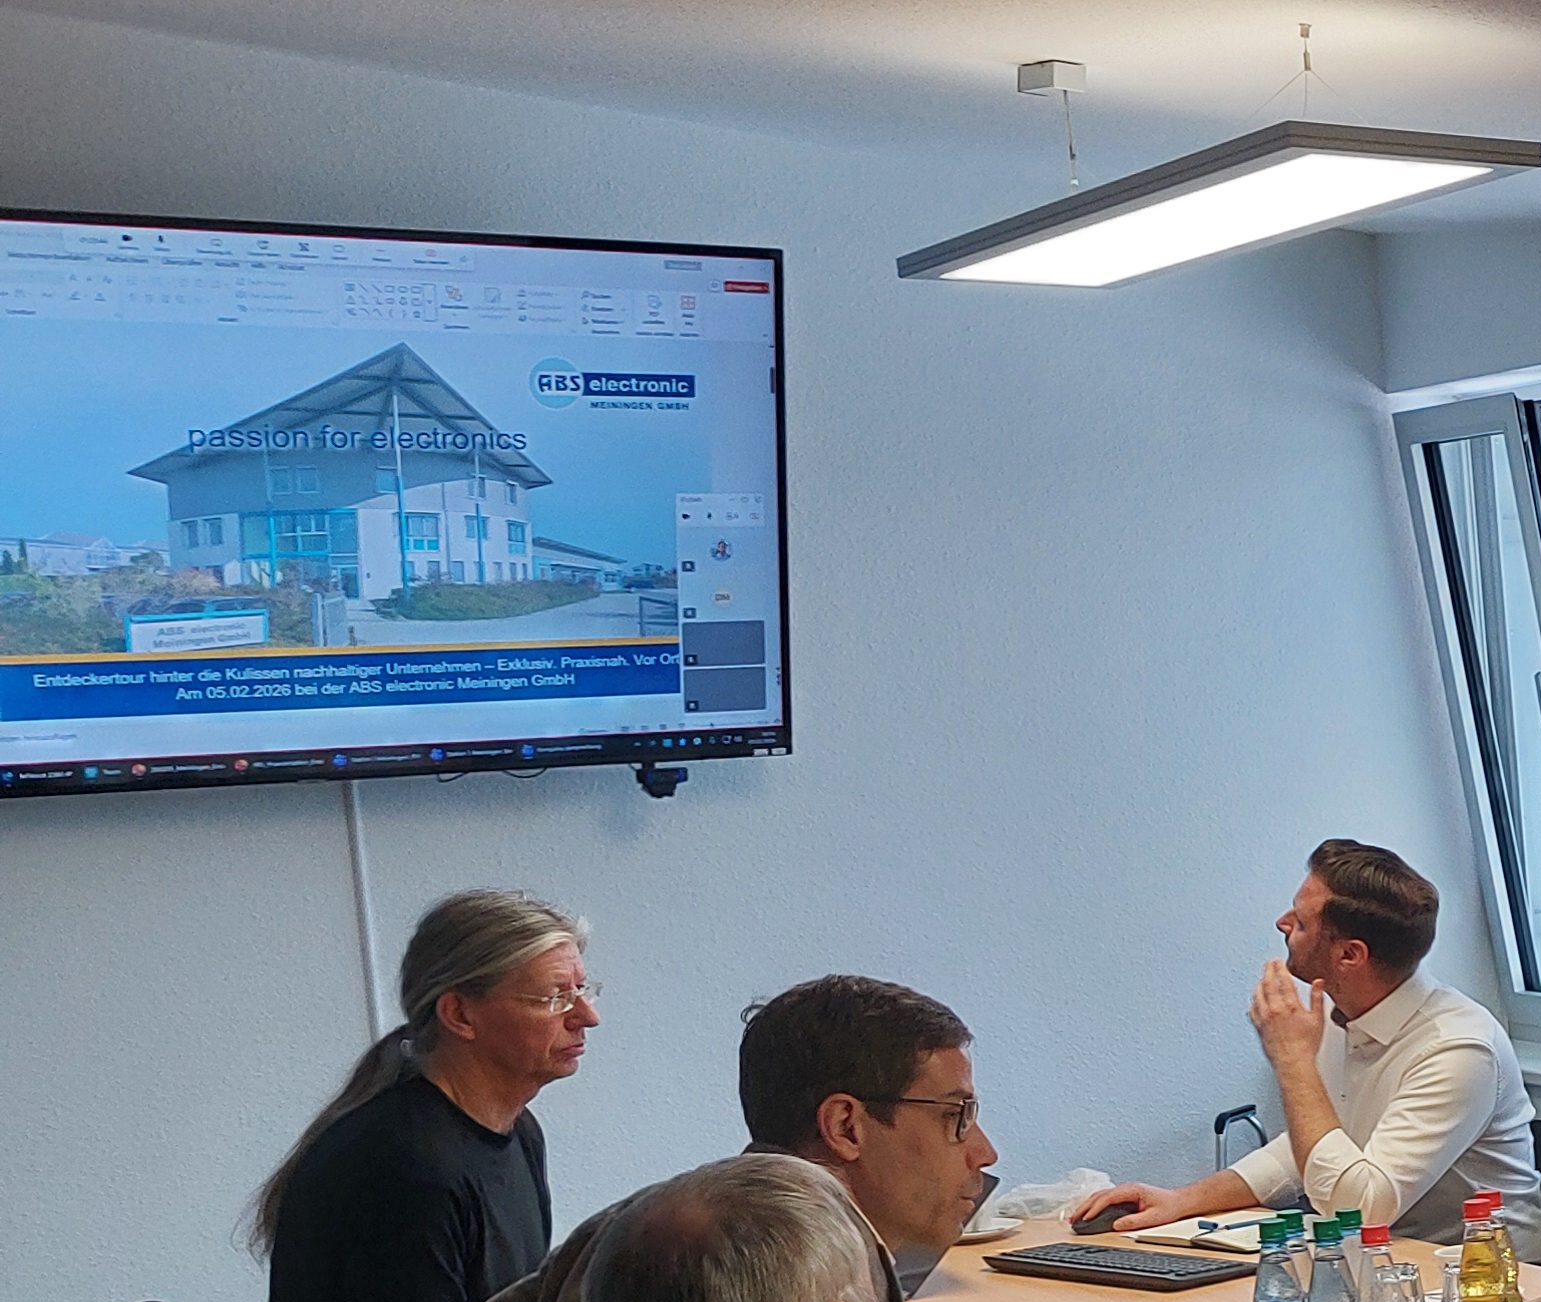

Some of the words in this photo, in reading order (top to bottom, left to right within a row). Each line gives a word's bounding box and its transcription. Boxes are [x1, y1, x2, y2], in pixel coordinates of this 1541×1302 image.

[538, 374, 581, 392] ABS
[589, 377, 689, 394] electronic
[188, 426, 309, 453] passion
[320, 425, 360, 449] for
[371, 426, 527, 450] electronics
[33, 672, 146, 688] Entdeckertour
[150, 669, 194, 684] hinter
[198, 668, 221, 682] die
[226, 665, 289, 681] Kulissen
[294, 661, 382, 679] nachhaltiger
[386, 660, 481, 676] Unternehmen
[497, 657, 557, 672] Exklusiv.
[561, 654, 630, 670] Praxisnah.
[633, 653, 655, 666] Vor
[176, 687, 202, 701] Am
[206, 684, 291, 700] 05.02.2026
[294, 683, 318, 697] bei
[321, 682, 346, 696] der
[349, 680, 382, 694] ABS
[386, 677, 454, 693] electronic
[457, 674, 528, 691] Meiningen
[531, 673, 575, 689] GmbH
